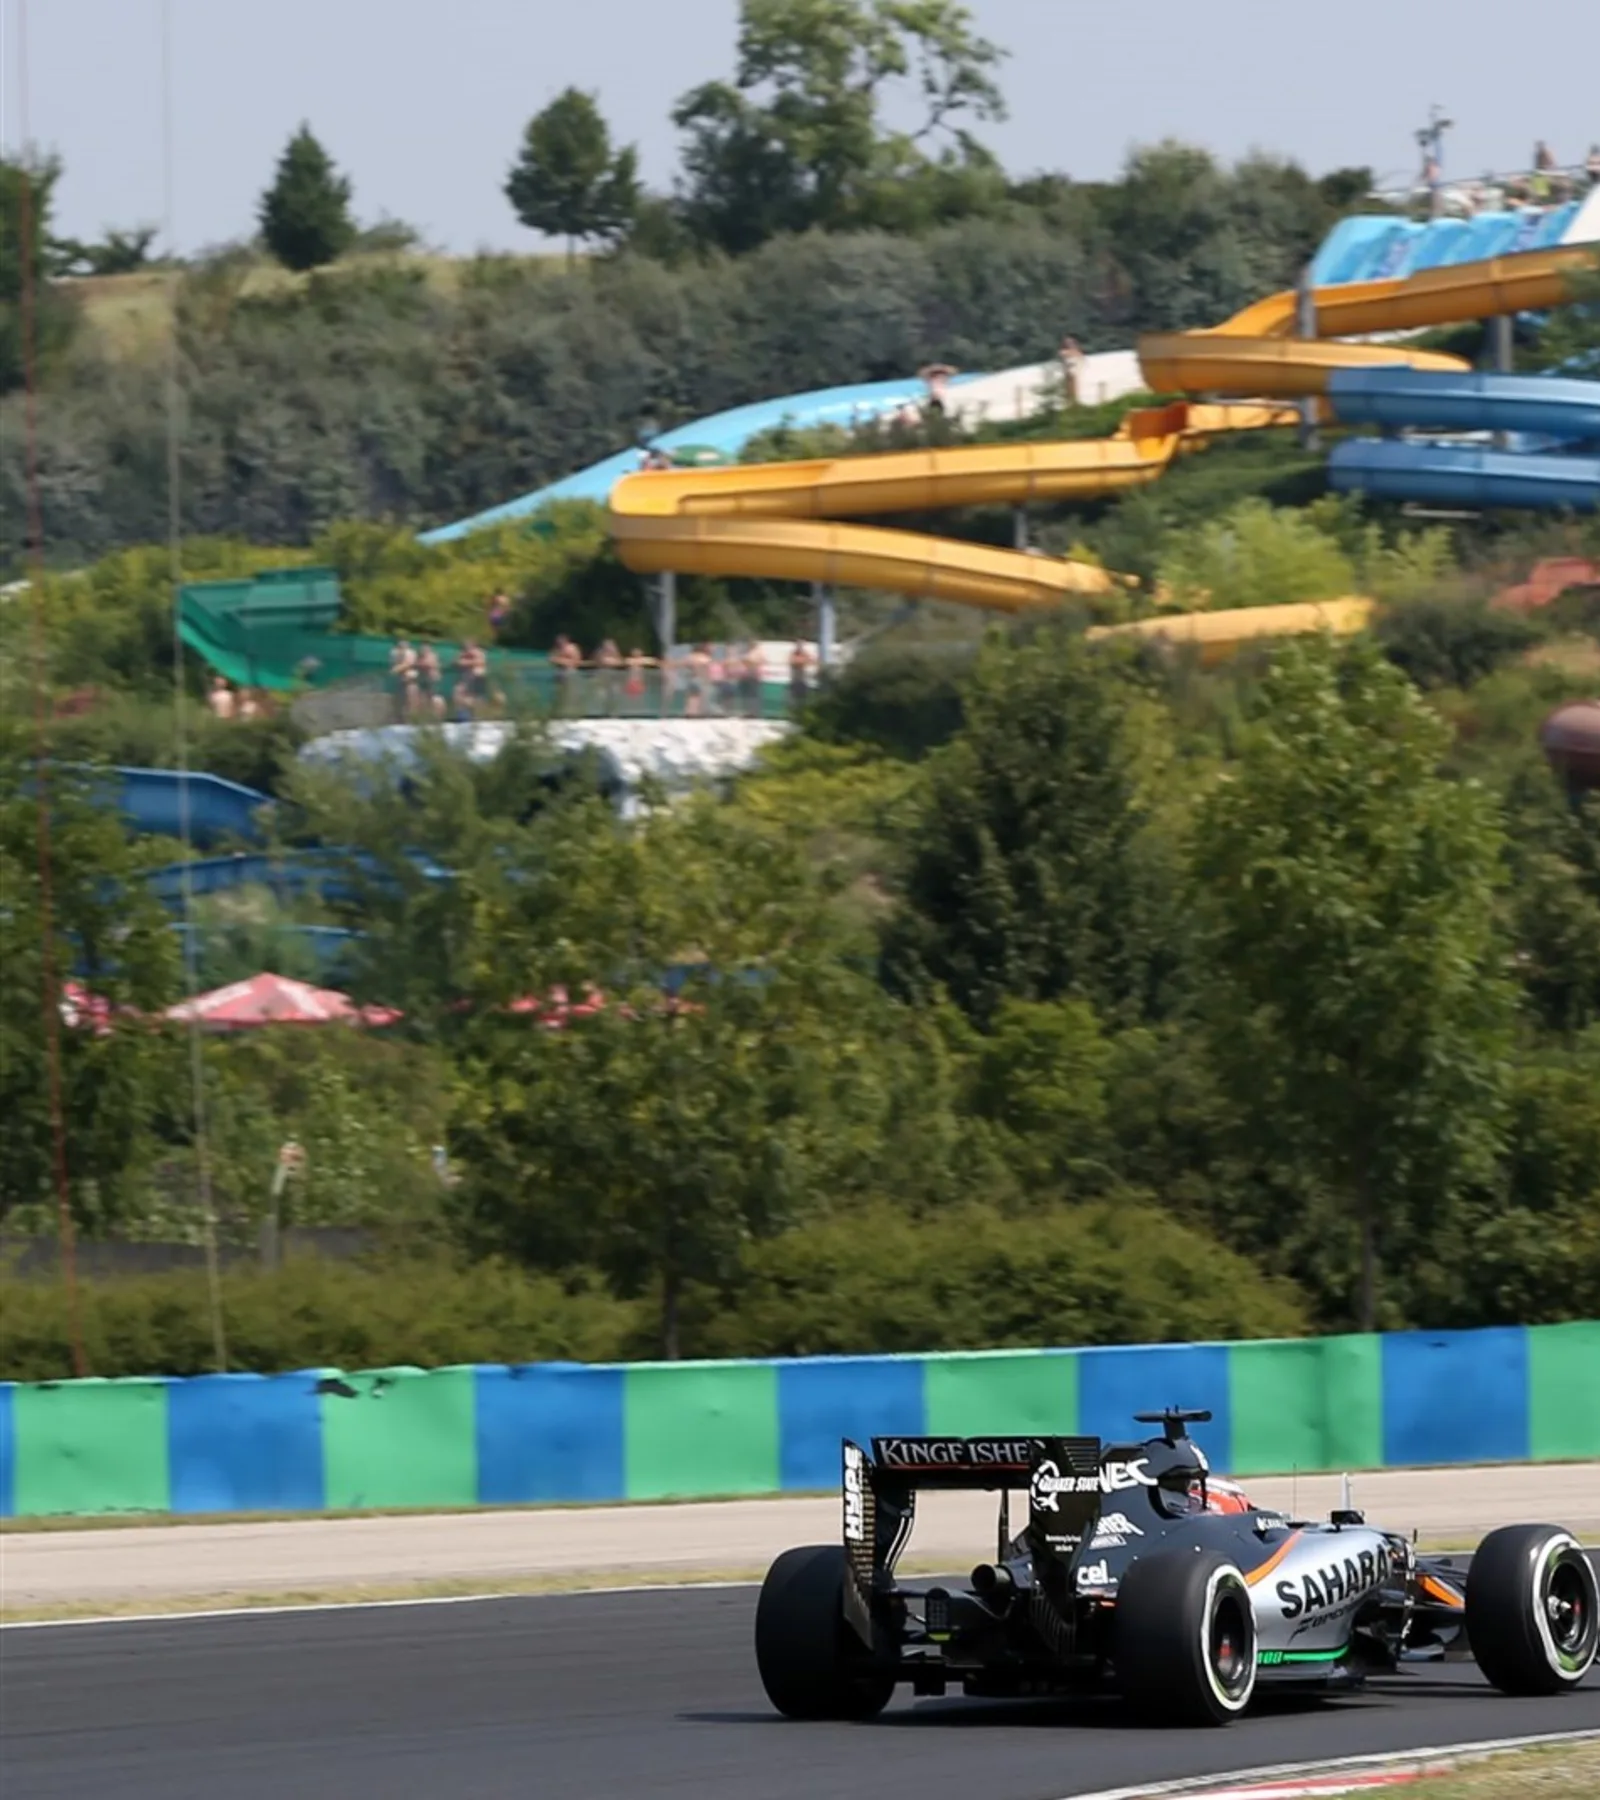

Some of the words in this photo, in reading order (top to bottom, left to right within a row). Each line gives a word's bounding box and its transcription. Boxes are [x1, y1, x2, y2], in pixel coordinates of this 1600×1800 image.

[878, 1440, 1031, 1464] KINGFISHE
[1099, 1458, 1158, 1493] NEC
[1276, 1538, 1392, 1619] SAHARA
